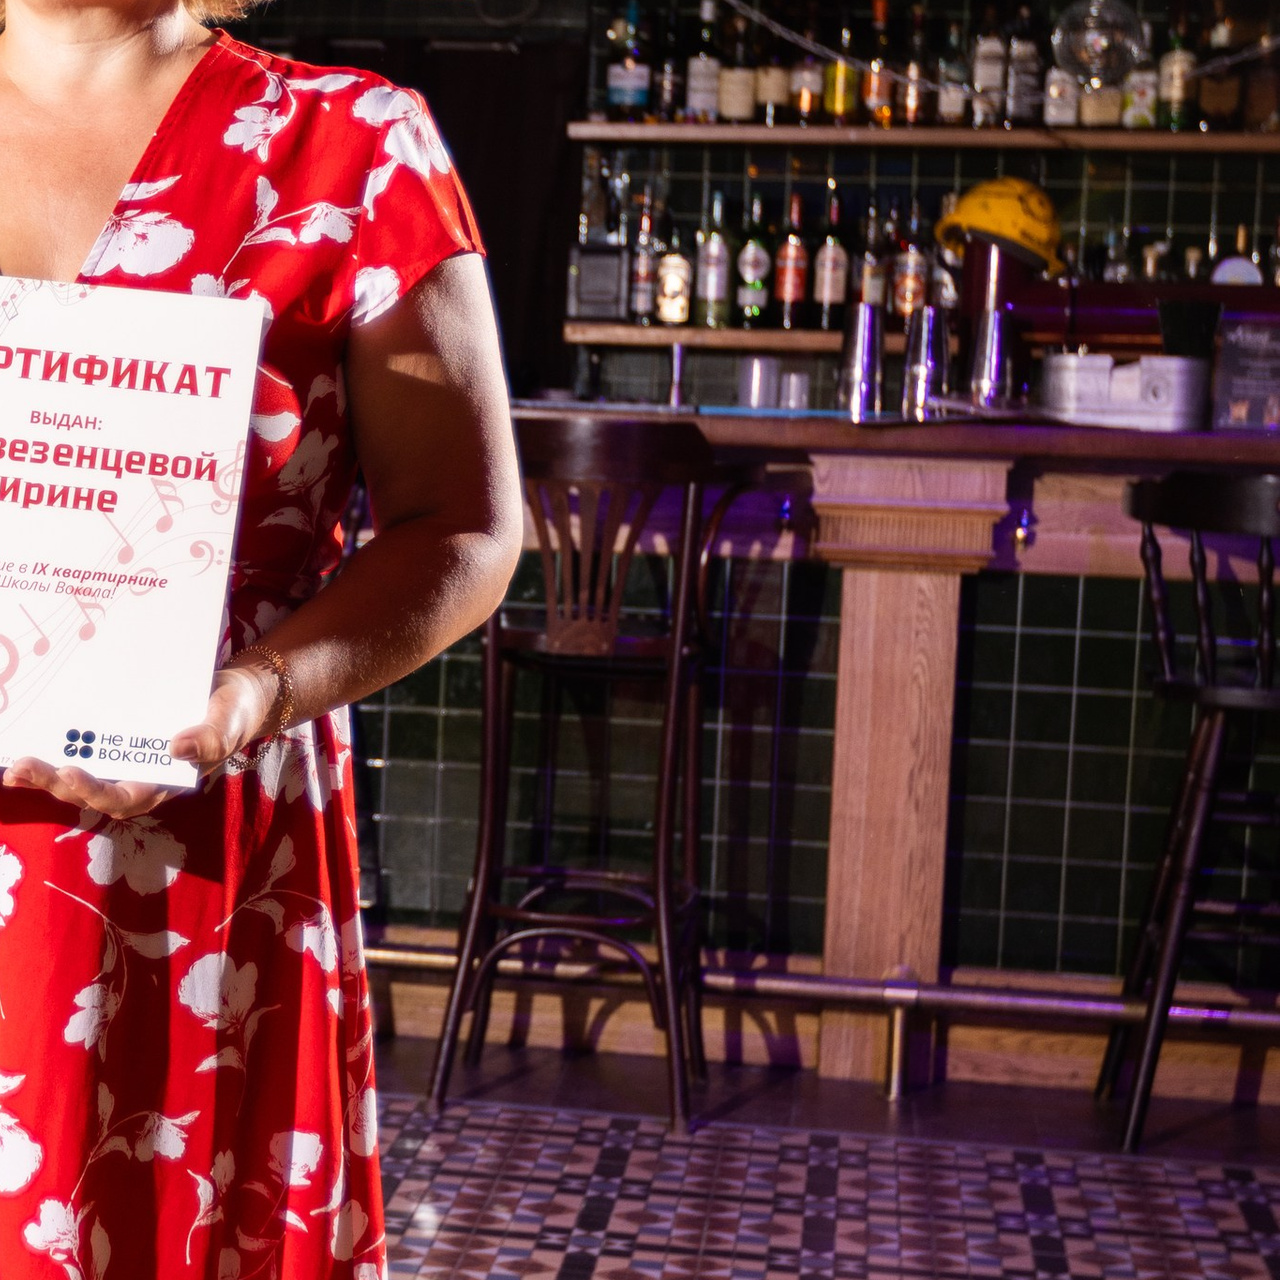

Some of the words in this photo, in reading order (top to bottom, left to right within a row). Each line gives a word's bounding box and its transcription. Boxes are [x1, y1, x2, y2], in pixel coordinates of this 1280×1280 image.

[29, 410, 103, 431] ВЫДАН:
[18, 563, 29, 574] в
[31, 561, 50, 576] IX
[51, 566, 169, 589] квартирнике
[54, 580, 118, 600] Вокала!
